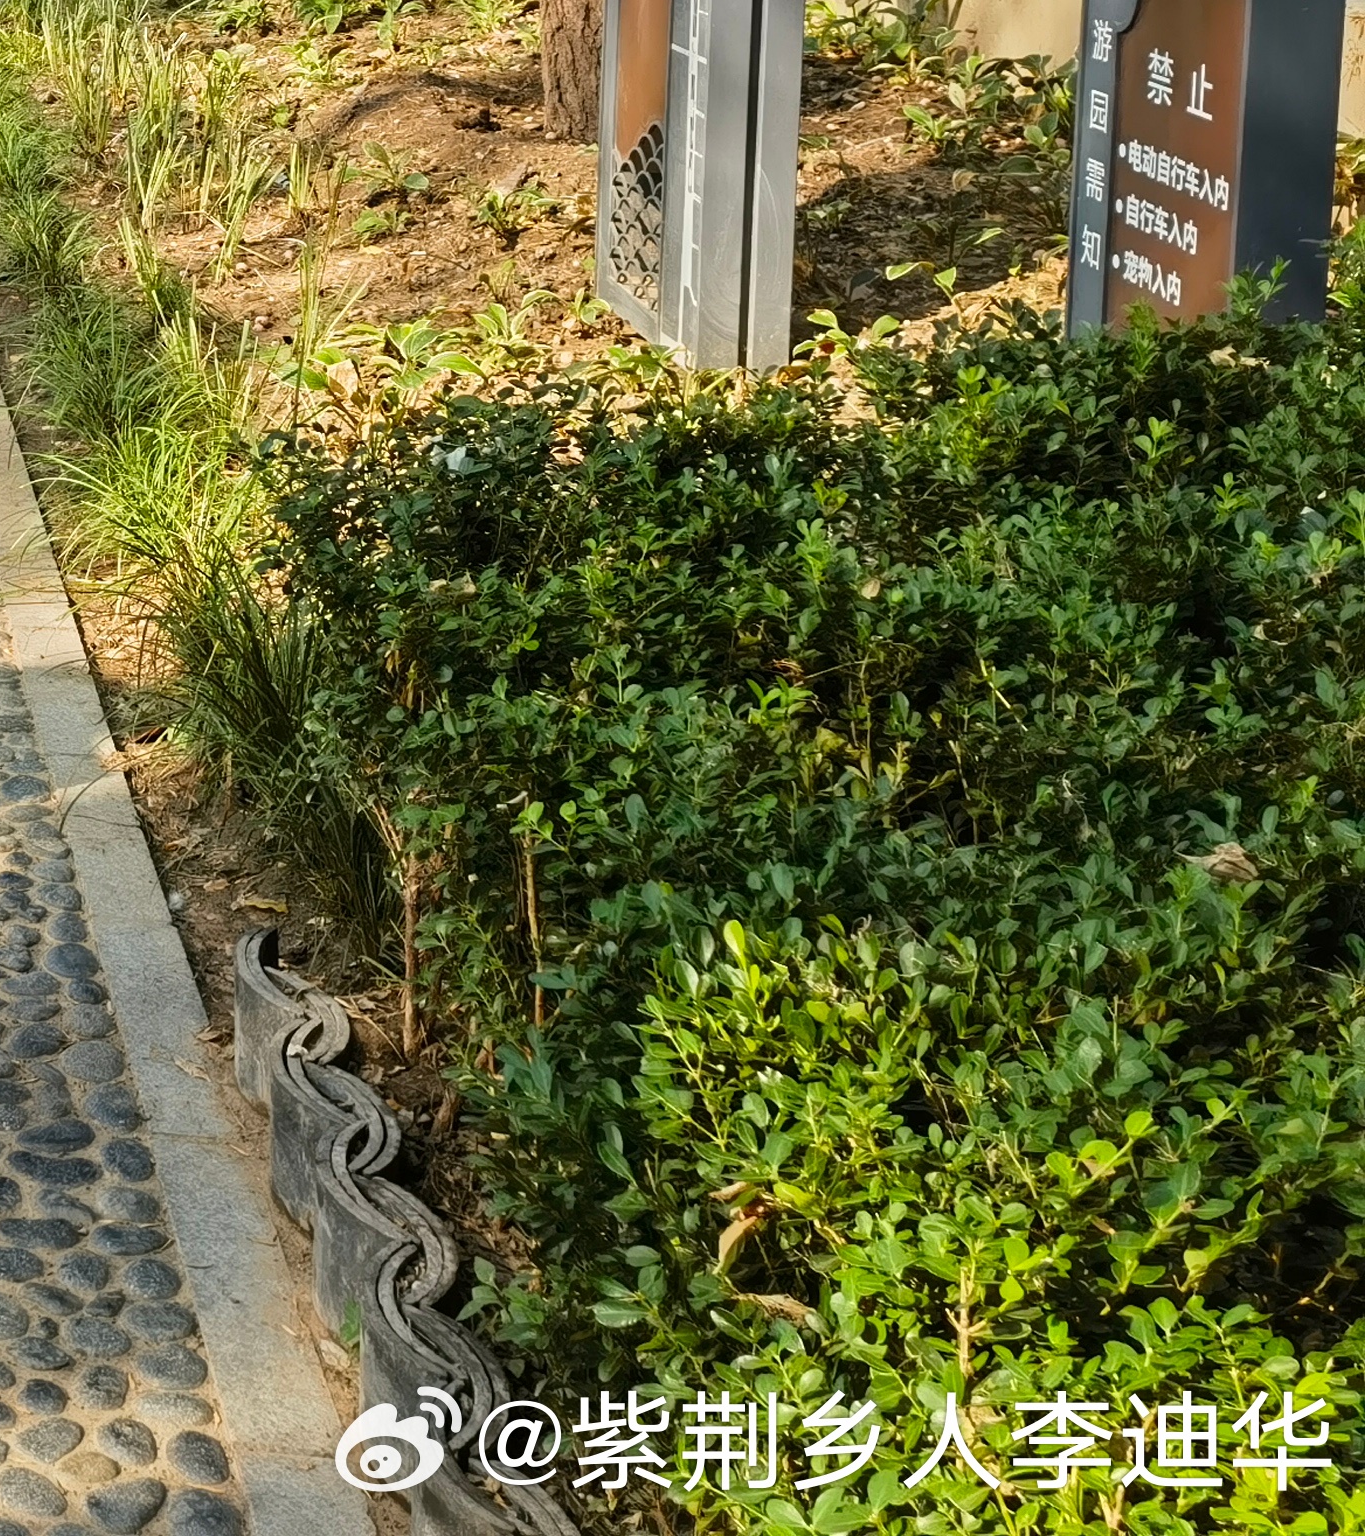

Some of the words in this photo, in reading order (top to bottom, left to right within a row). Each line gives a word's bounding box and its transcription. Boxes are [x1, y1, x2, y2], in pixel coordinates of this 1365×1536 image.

[1146, 47, 1214, 122] 禁止
[1080, 19, 1113, 271] 游园需知
[1127, 139, 1230, 212] 电动自行车入内
[1125, 193, 1198, 256] 自行车入内
[1122, 250, 1182, 307] 宠物入内
